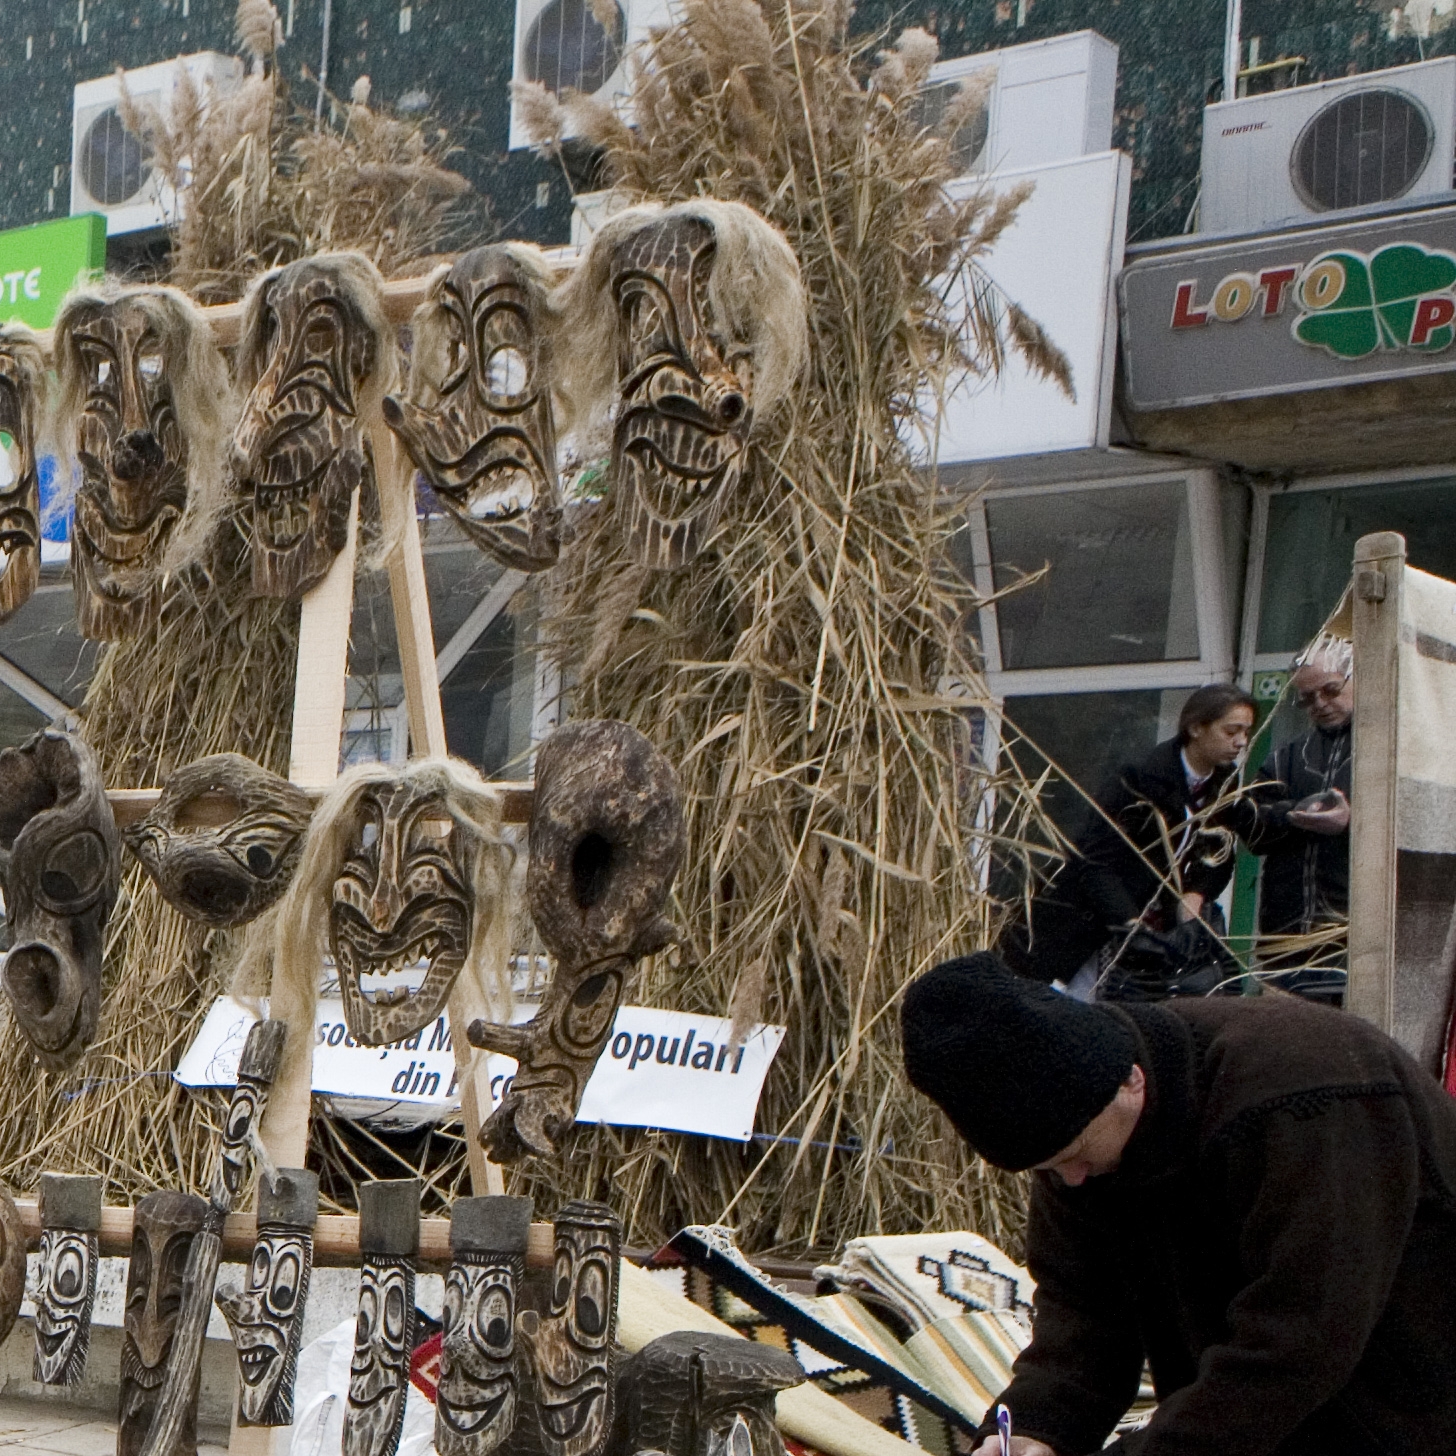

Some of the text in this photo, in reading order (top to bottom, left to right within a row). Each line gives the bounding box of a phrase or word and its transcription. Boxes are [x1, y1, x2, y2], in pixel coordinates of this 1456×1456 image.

[1171, 259, 1347, 329] LOTO
[610, 1027, 746, 1075] opulari
[391, 1060, 442, 1097] din
